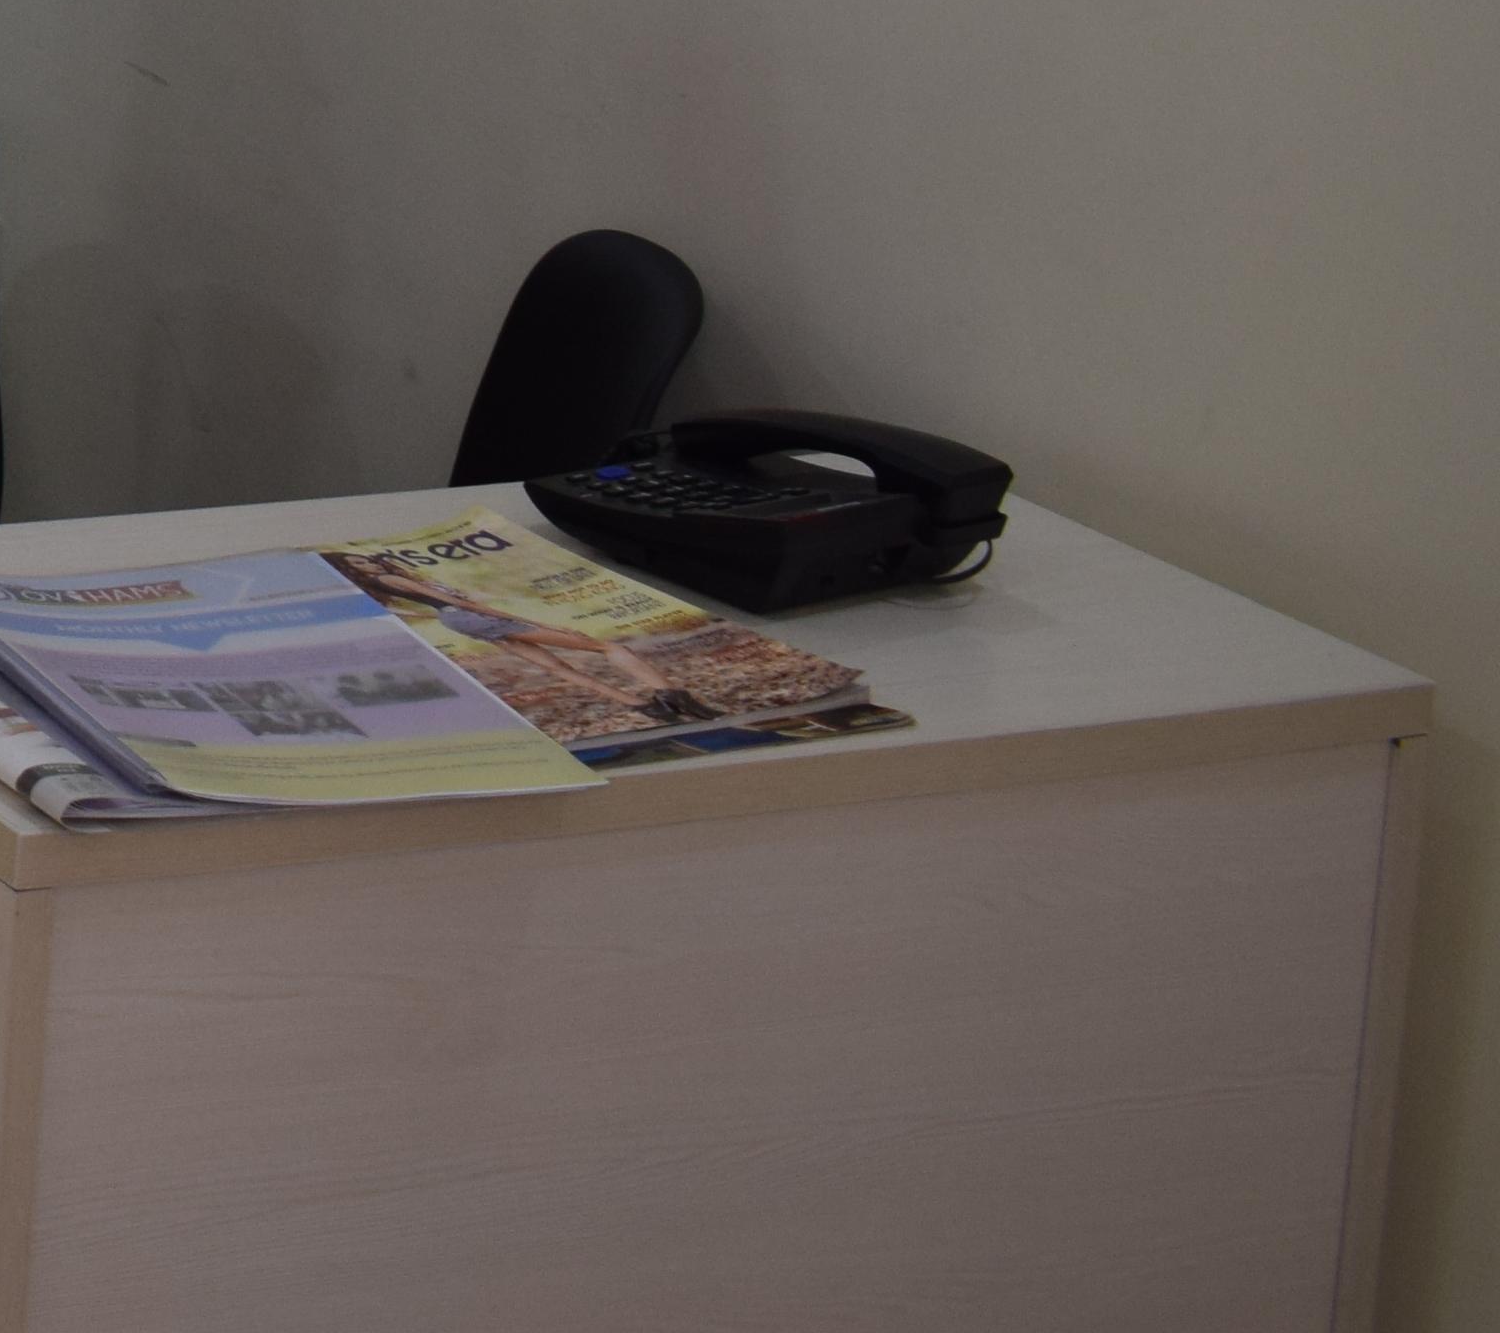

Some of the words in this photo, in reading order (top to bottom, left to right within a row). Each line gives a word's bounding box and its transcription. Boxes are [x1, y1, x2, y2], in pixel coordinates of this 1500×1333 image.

[427, 529, 514, 561] era
[53, 622, 164, 636] MONTHLY
[169, 609, 317, 632] NEWSLETTER
